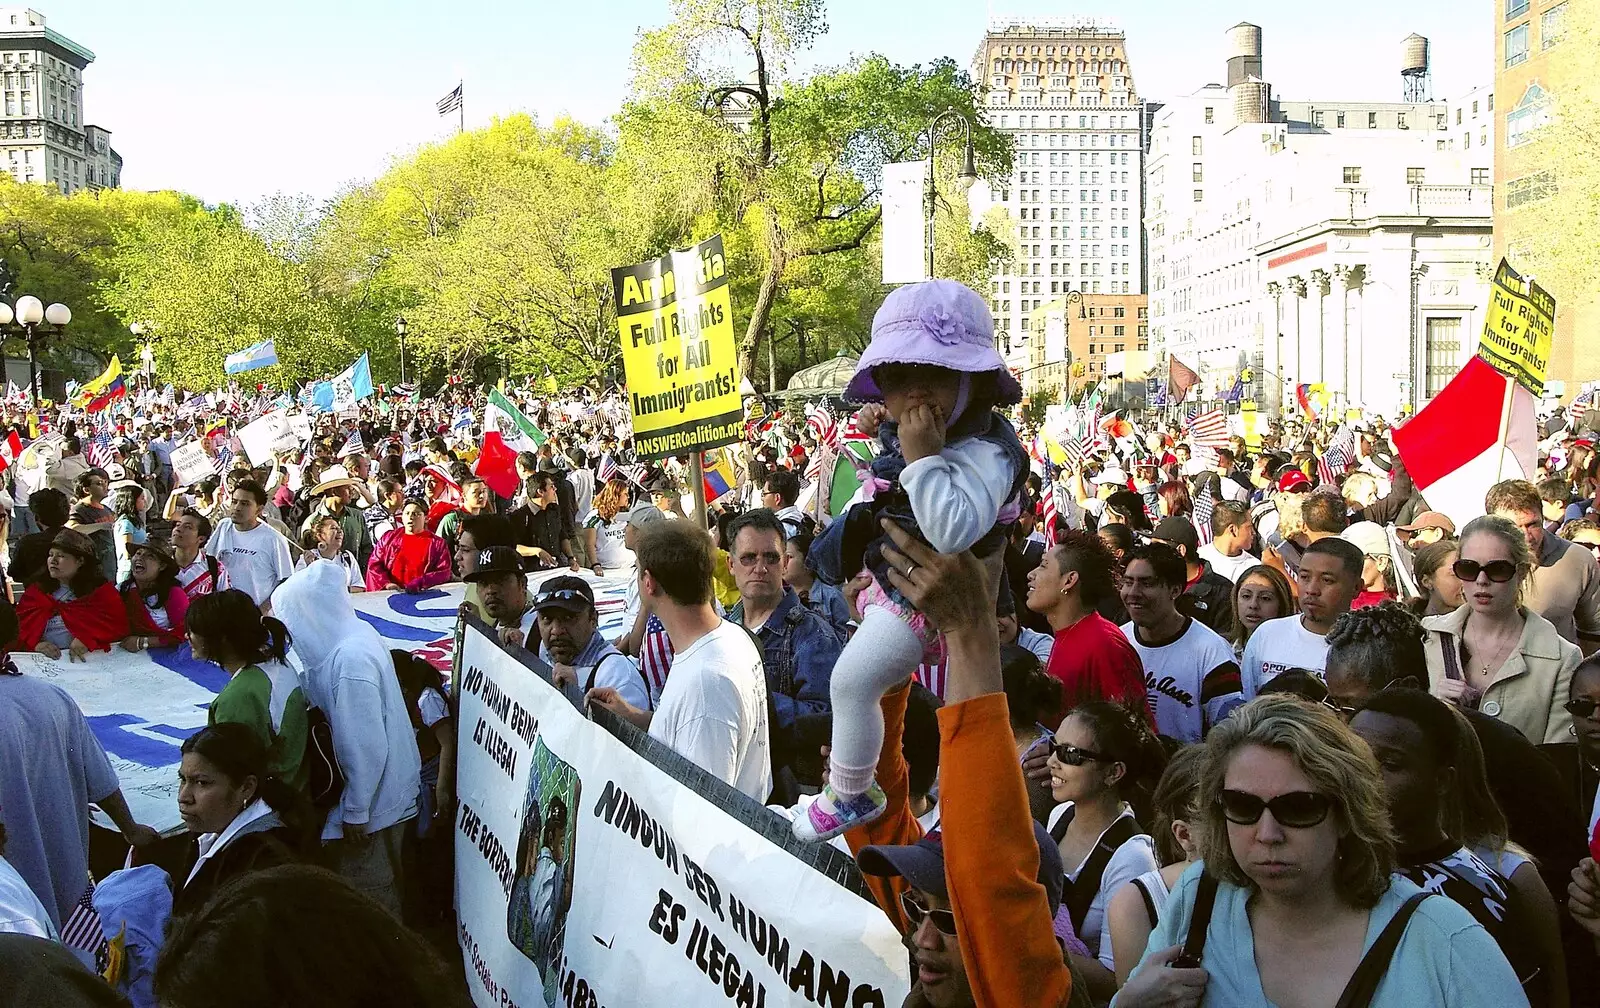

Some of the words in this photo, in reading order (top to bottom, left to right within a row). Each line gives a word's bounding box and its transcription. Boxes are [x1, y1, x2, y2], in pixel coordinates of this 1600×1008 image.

[630, 315, 667, 348] Full
[670, 302, 724, 340] Rights
[1494, 290, 1515, 314] Full
[1518, 304, 1549, 337] Rights
[1500, 315, 1520, 335] for
[1523, 325, 1538, 348] All
[656, 352, 678, 380] for
[685, 339, 711, 371] All
[1484, 322, 1546, 374] Immigrants!
[633, 367, 736, 417] Immigrants!
[636, 421, 744, 457] ANSWERCoalition.org
[463, 665, 484, 696] NO
[481, 675, 512, 725] HUMAN
[511, 701, 539, 750] BEING
[472, 716, 487, 746] IS
[484, 725, 518, 782] ILLEGAL
[459, 803, 481, 844] THE
[593, 780, 679, 876] NINGUN
[682, 853, 726, 923] SER
[648, 887, 687, 945] ES
